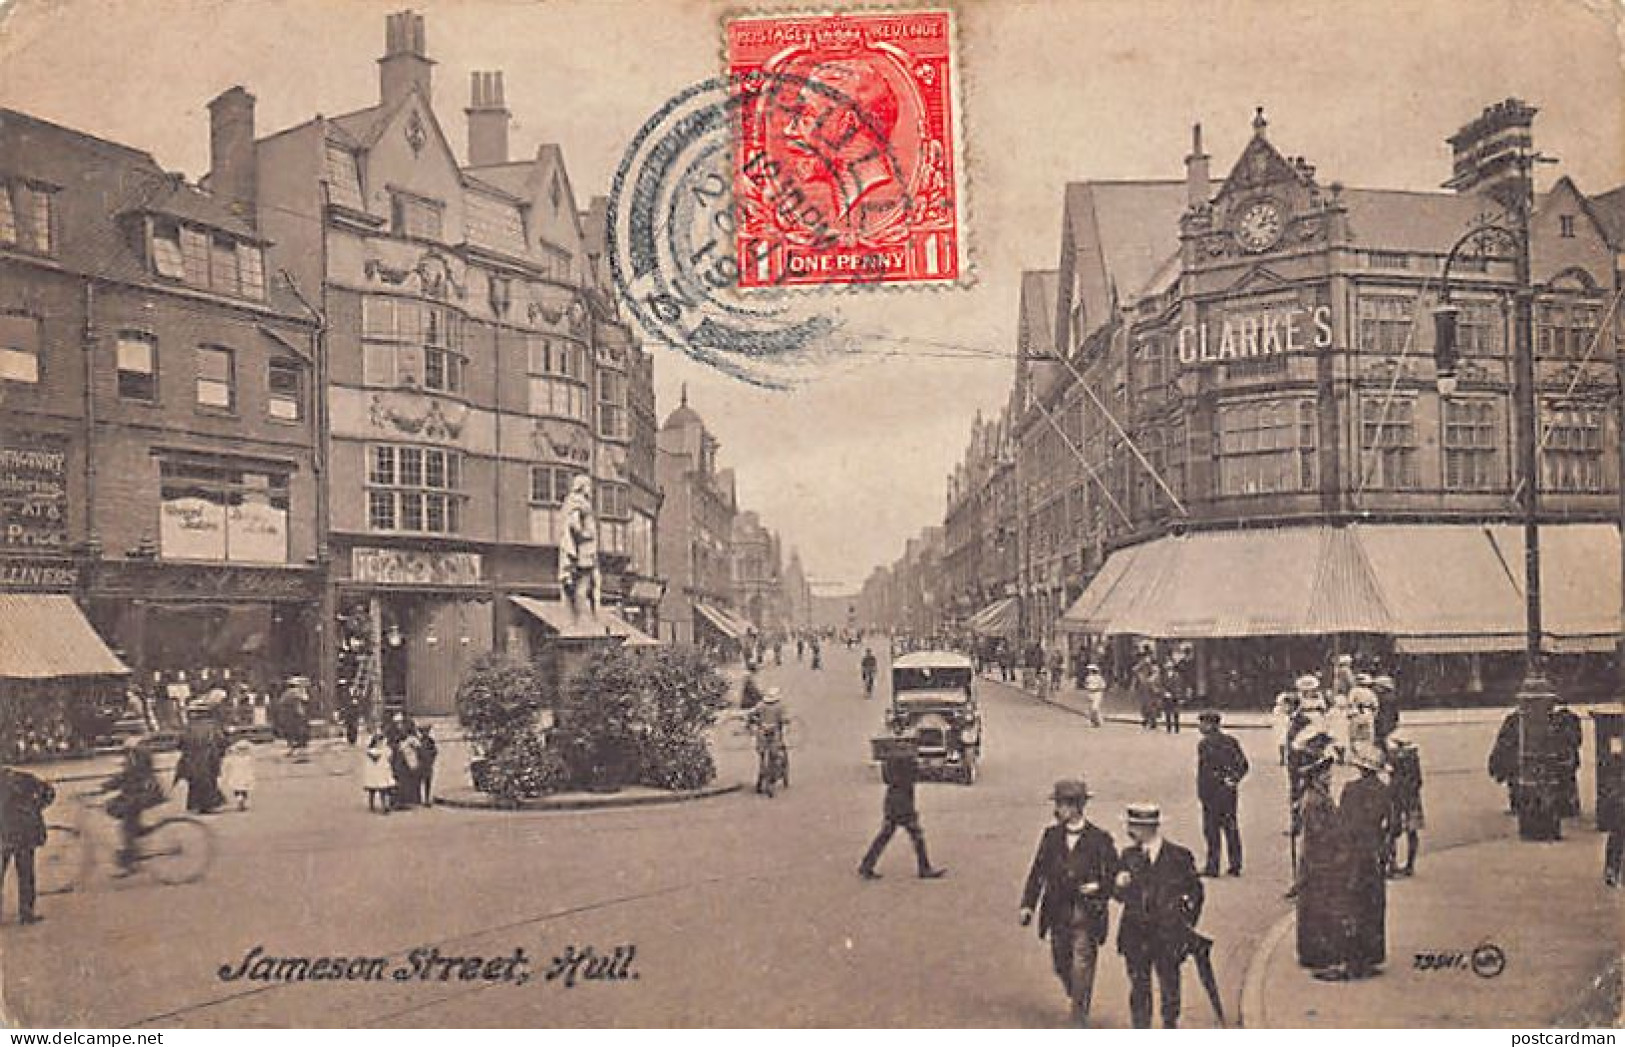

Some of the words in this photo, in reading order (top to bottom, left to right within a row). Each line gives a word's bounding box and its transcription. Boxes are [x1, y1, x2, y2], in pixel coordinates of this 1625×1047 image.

[736, 24, 804, 46] POSTAGE
[873, 21, 943, 40] REVENUE
[790, 254, 832, 273] ONE
[835, 251, 906, 269] PENNY
[925, 232, 938, 274] 1
[1178, 306, 1333, 364] CLARKE'S
